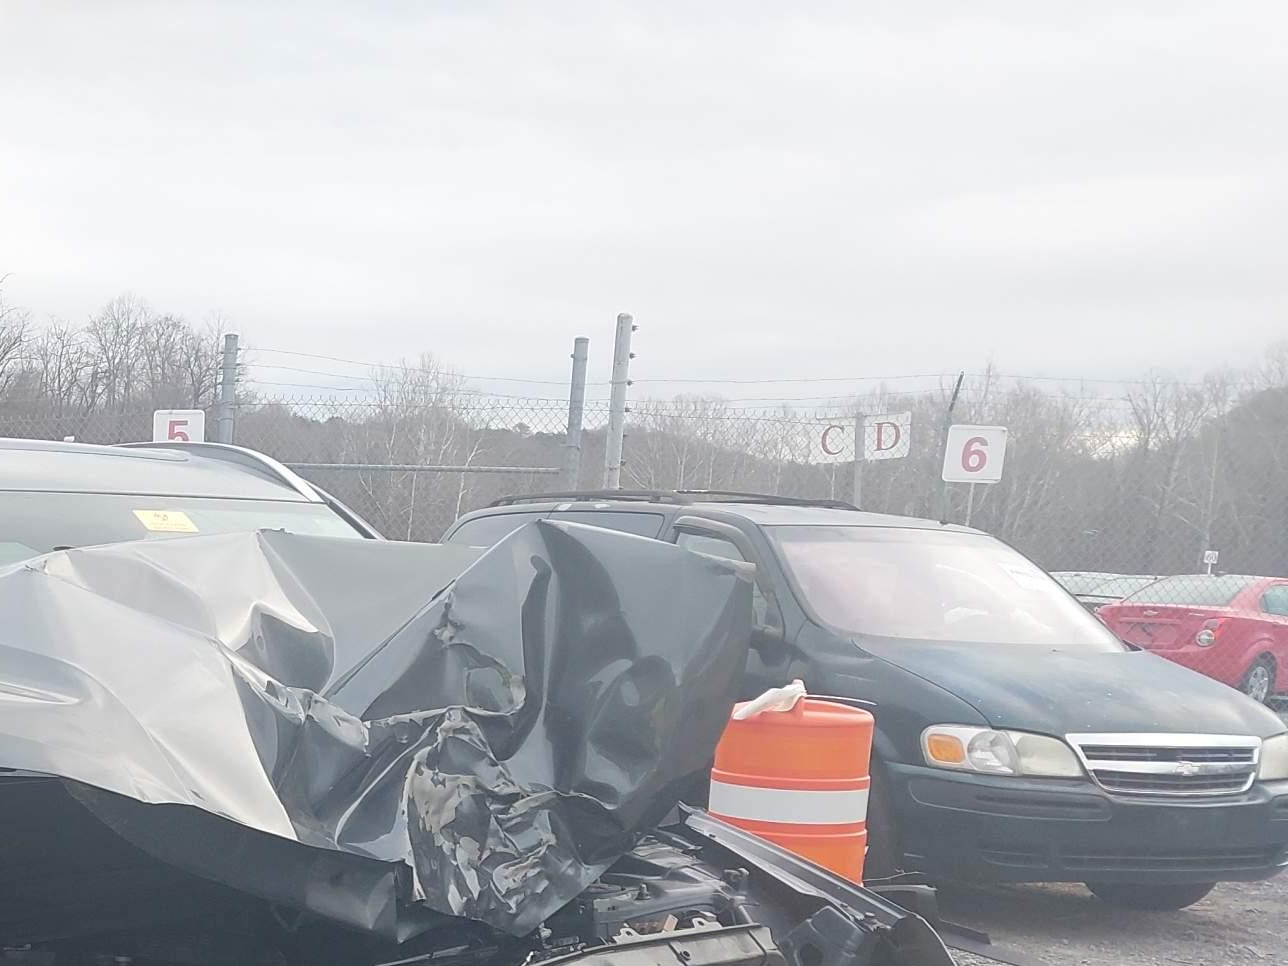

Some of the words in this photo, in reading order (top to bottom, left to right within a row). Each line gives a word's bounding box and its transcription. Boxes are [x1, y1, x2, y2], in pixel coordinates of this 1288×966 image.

[167, 420, 190, 441] 5
[821, 425, 845, 456] C
[873, 421, 902, 452] D
[962, 436, 989, 473] 6
